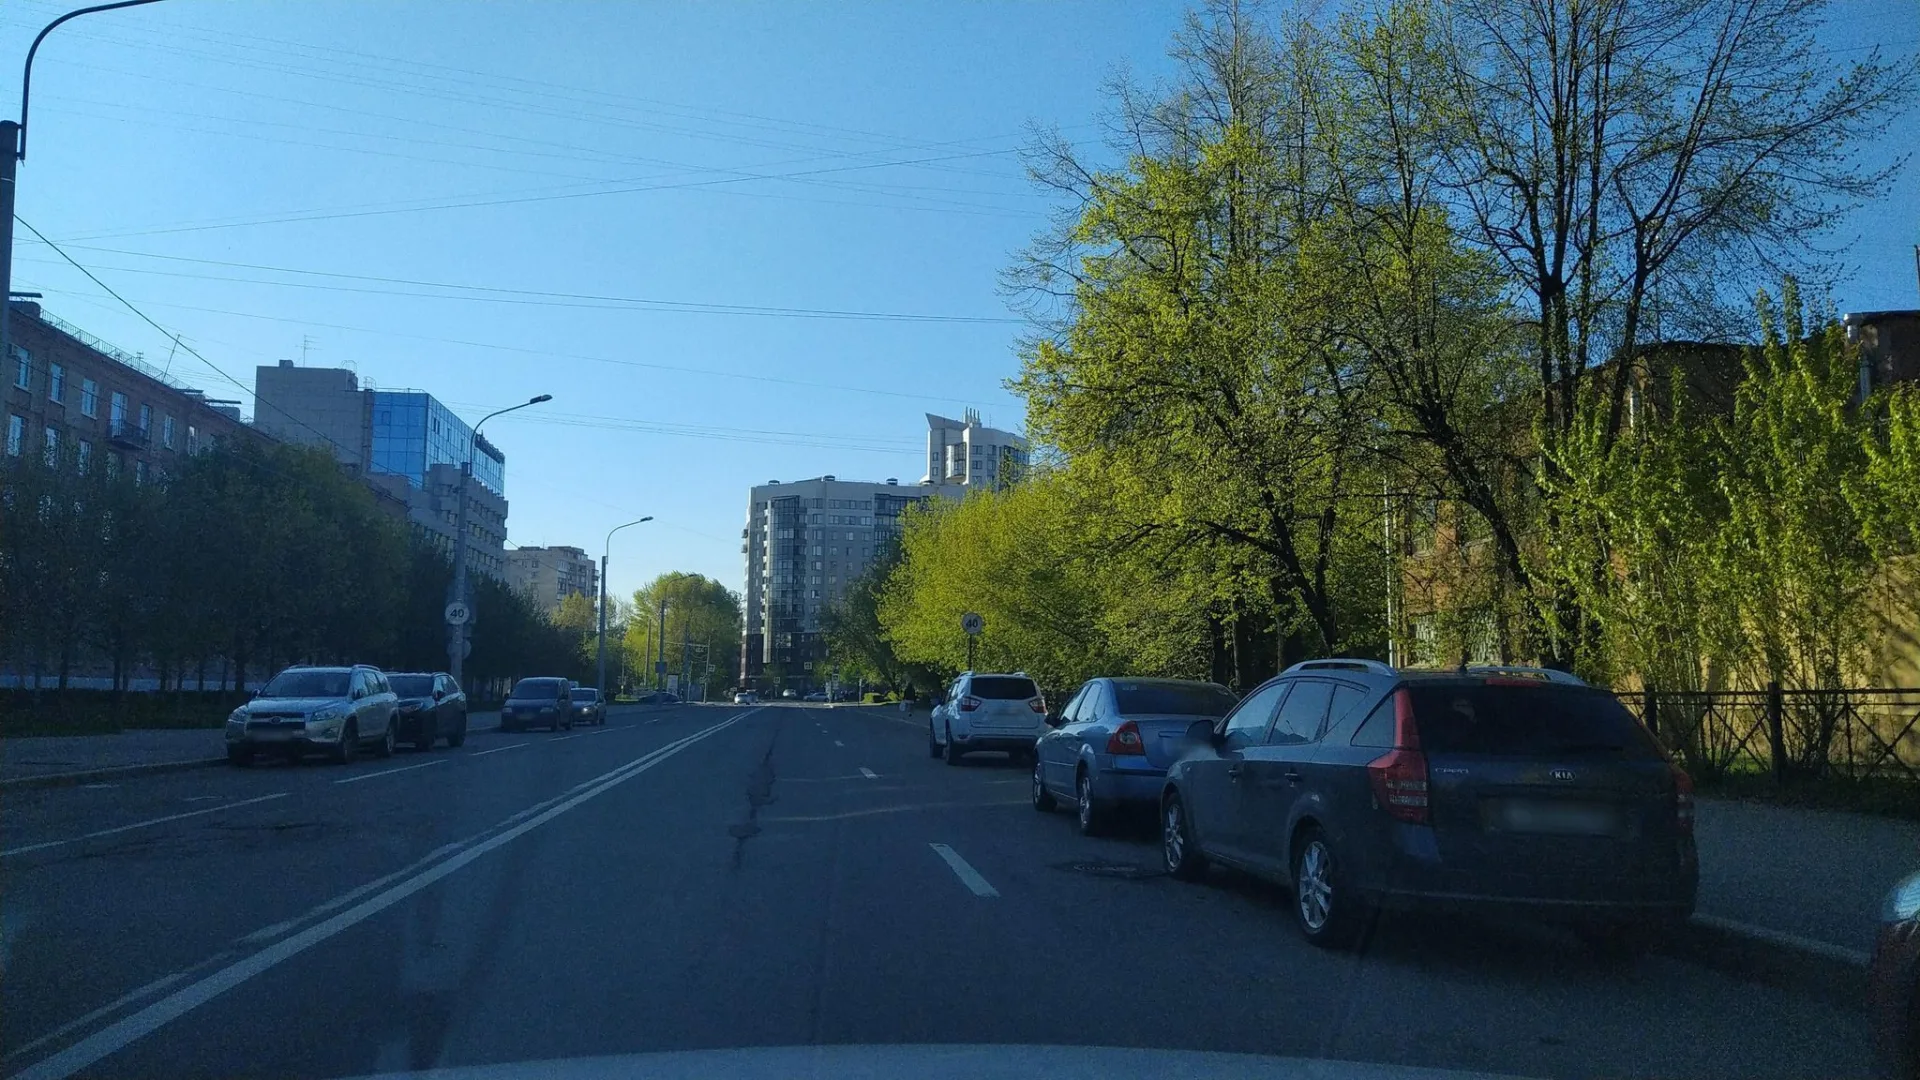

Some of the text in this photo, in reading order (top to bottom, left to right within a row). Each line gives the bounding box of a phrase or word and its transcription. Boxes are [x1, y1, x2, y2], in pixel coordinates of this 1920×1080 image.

[450, 608, 464, 618] 40
[965, 619, 978, 628] 40
[1554, 771, 1574, 780] KIA
